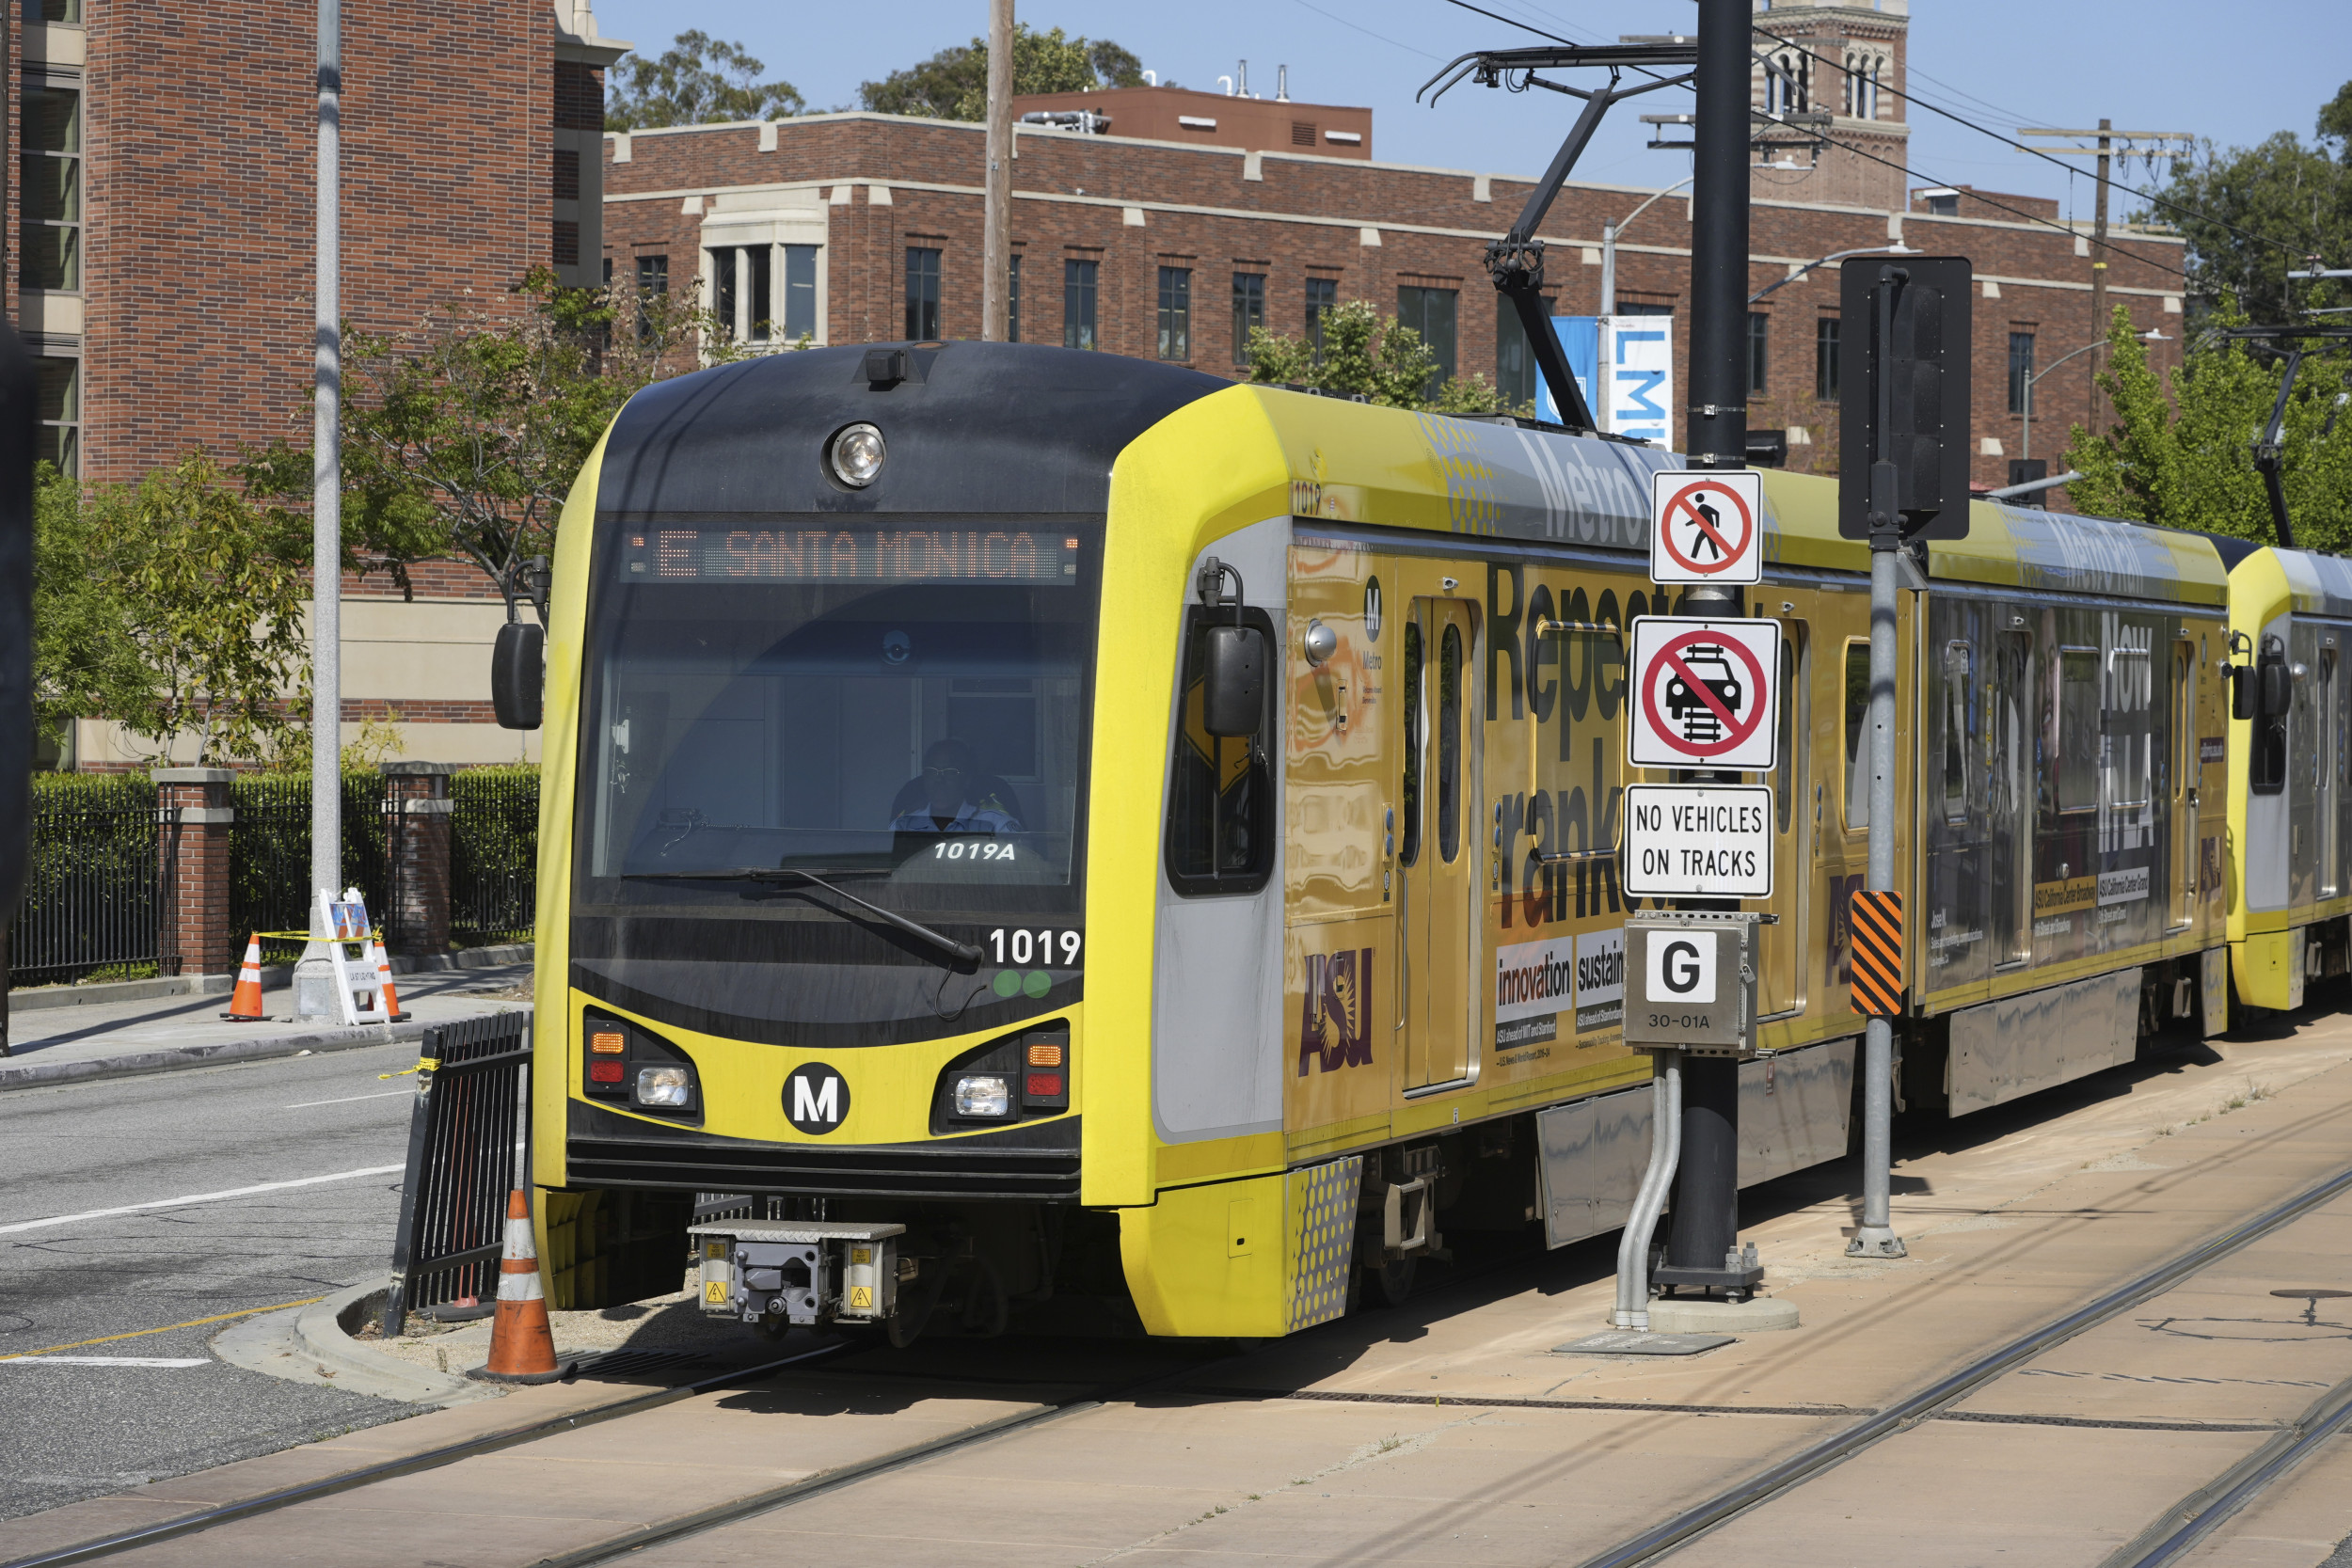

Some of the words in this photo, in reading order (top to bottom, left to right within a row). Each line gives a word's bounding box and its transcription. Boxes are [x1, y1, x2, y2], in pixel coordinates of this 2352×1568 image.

[1295, 482, 1322, 515] 1019
[1516, 431, 1643, 546] Metro
[660, 531, 697, 577] E
[726, 531, 856, 578] SANTA
[877, 531, 1036, 578] MONICA
[2043, 514, 2113, 593] Metro
[2095, 521, 2143, 594] Rail
[1367, 588, 1379, 630] M
[1363, 650, 1382, 671] Metro
[2101, 611, 2153, 714] Now
[1502, 737, 1677, 929] rank
[1636, 804, 1662, 832] NO
[1671, 805, 1763, 834] VEHICLES
[934, 843, 1016, 861] 1019A
[1643, 848, 1670, 876] ON
[1680, 849, 1756, 878] TRACKS
[2044, 887, 2063, 908] California
[2063, 885, 2076, 905] Center
[2076, 882, 2096, 904] Broadway
[2107, 877, 2125, 896] California
[2125, 875, 2137, 894] Center
[2137, 872, 2149, 892] Grand
[991, 928, 1082, 965] 1019
[1579, 941, 1623, 991] sustain
[1499, 951, 1570, 1006] innovation
[1661, 941, 1700, 994] G
[1297, 947, 1374, 1078] ASU
[1497, 1029, 1505, 1044] ASU
[1506, 1026, 1518, 1043] ahead
[1518, 1025, 1523, 1040] of
[1523, 1024, 1532, 1039] MIT
[1531, 1022, 1539, 1037] and
[1539, 1019, 1556, 1036] Stanford
[1577, 1013, 1585, 1027] ASU
[1584, 1010, 1597, 1026] ahead
[1597, 1009, 1601, 1022] of
[1601, 1006, 1617, 1022] Stanford
[1648, 1013, 1710, 1029] 30-01A
[794, 1075, 838, 1122] M
